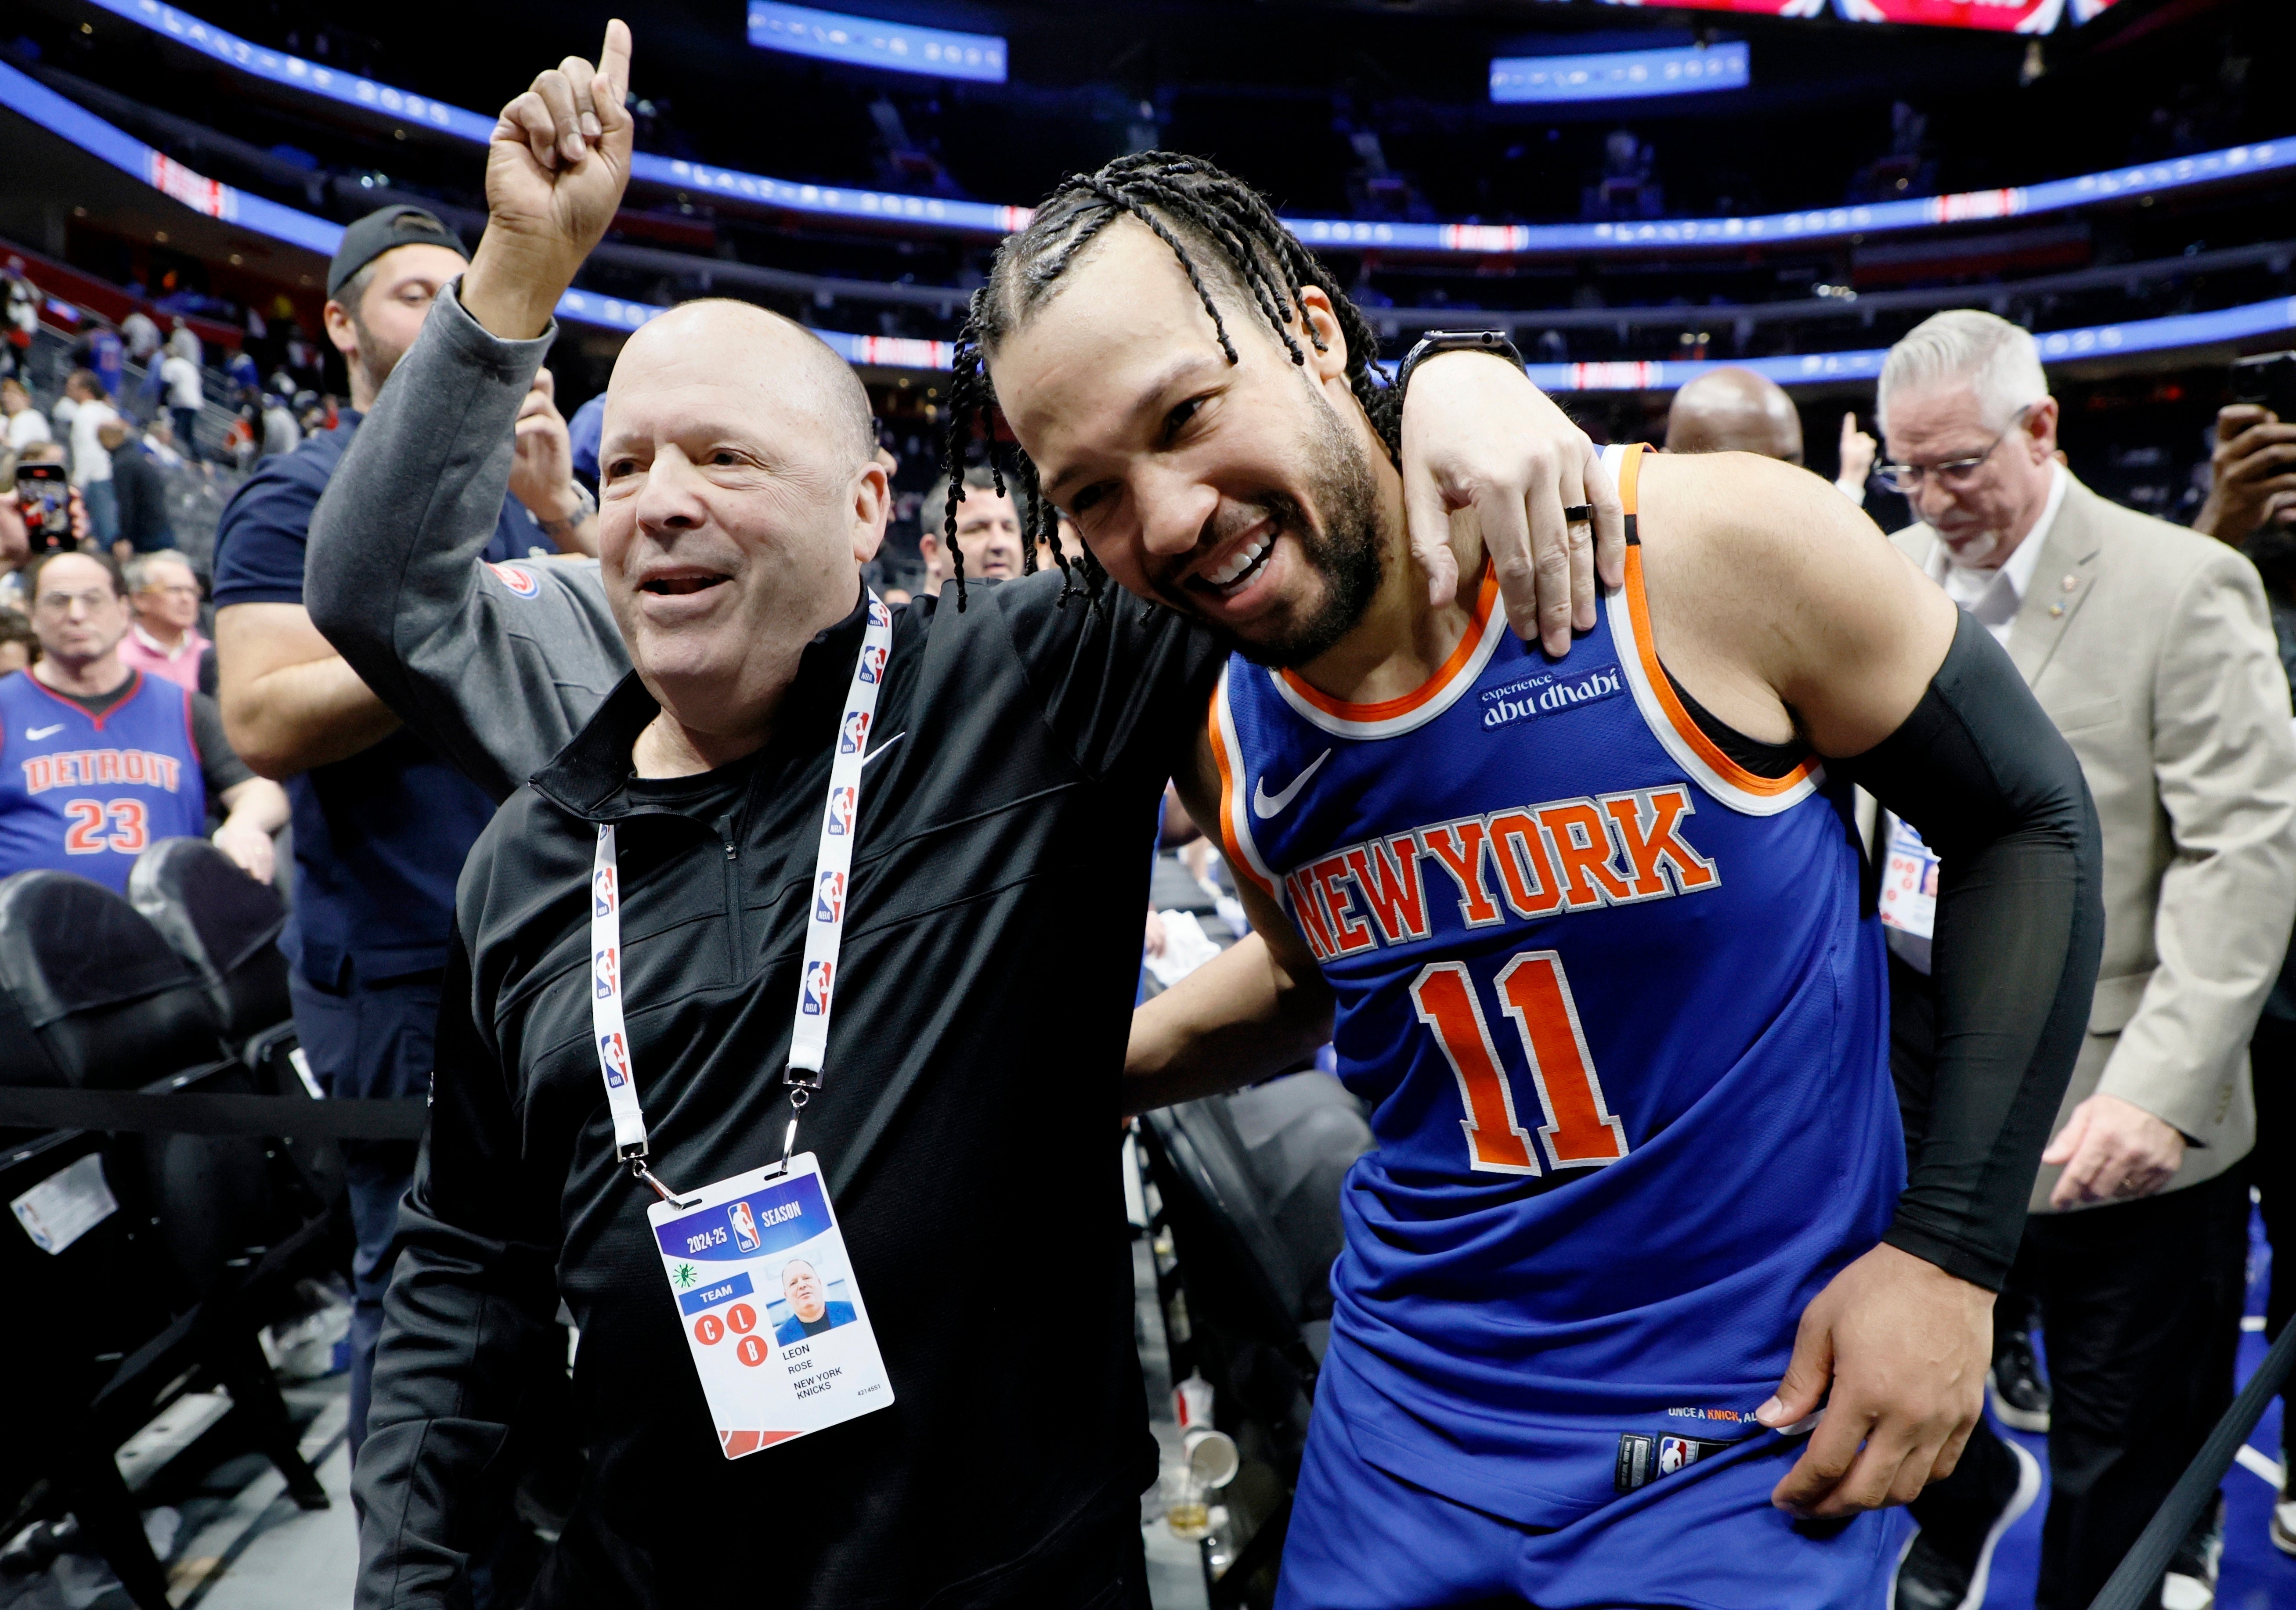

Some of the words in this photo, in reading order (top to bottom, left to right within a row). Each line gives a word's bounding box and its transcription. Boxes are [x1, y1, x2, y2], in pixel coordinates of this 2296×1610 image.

[861, 672, 872, 681] NBA
[1481, 674, 1552, 702] experience
[1485, 697, 1537, 726] abu
[1540, 668, 1621, 710] dhabi
[842, 744, 853, 752] NBA
[21, 748, 181, 796] DETROIT
[64, 798, 150, 855] 23
[830, 825, 842, 833] NBA
[1288, 827, 1432, 964] NEW
[1418, 783, 1722, 929] YORK
[598, 905, 608, 916] NBA
[818, 910, 830, 920] NBA
[598, 987, 610, 998] NBA
[805, 1003, 817, 1012] NBA
[1408, 950, 1630, 1177] 11
[610, 1075, 622, 1087] NBA
[686, 1226, 728, 1253] 2024-25
[761, 1201, 802, 1228] SEASON
[741, 1239, 753, 1250] NBA
[700, 1284, 733, 1303] TEAM
[704, 1320, 716, 1341] C
[736, 1309, 748, 1329] L
[745, 1340, 759, 1361] B
[783, 1344, 810, 1360] LEON
[788, 1359, 813, 1374] ROSE
[794, 1376, 814, 1390] NEW
[816, 1367, 842, 1382] YORK
[797, 1382, 831, 1400] KNICKS
[857, 1384, 881, 1396] 4214551
[1668, 1407, 1697, 1417] ONCE
[1698, 1408, 1705, 1419] A
[1708, 1409, 1742, 1423] KNICK,
